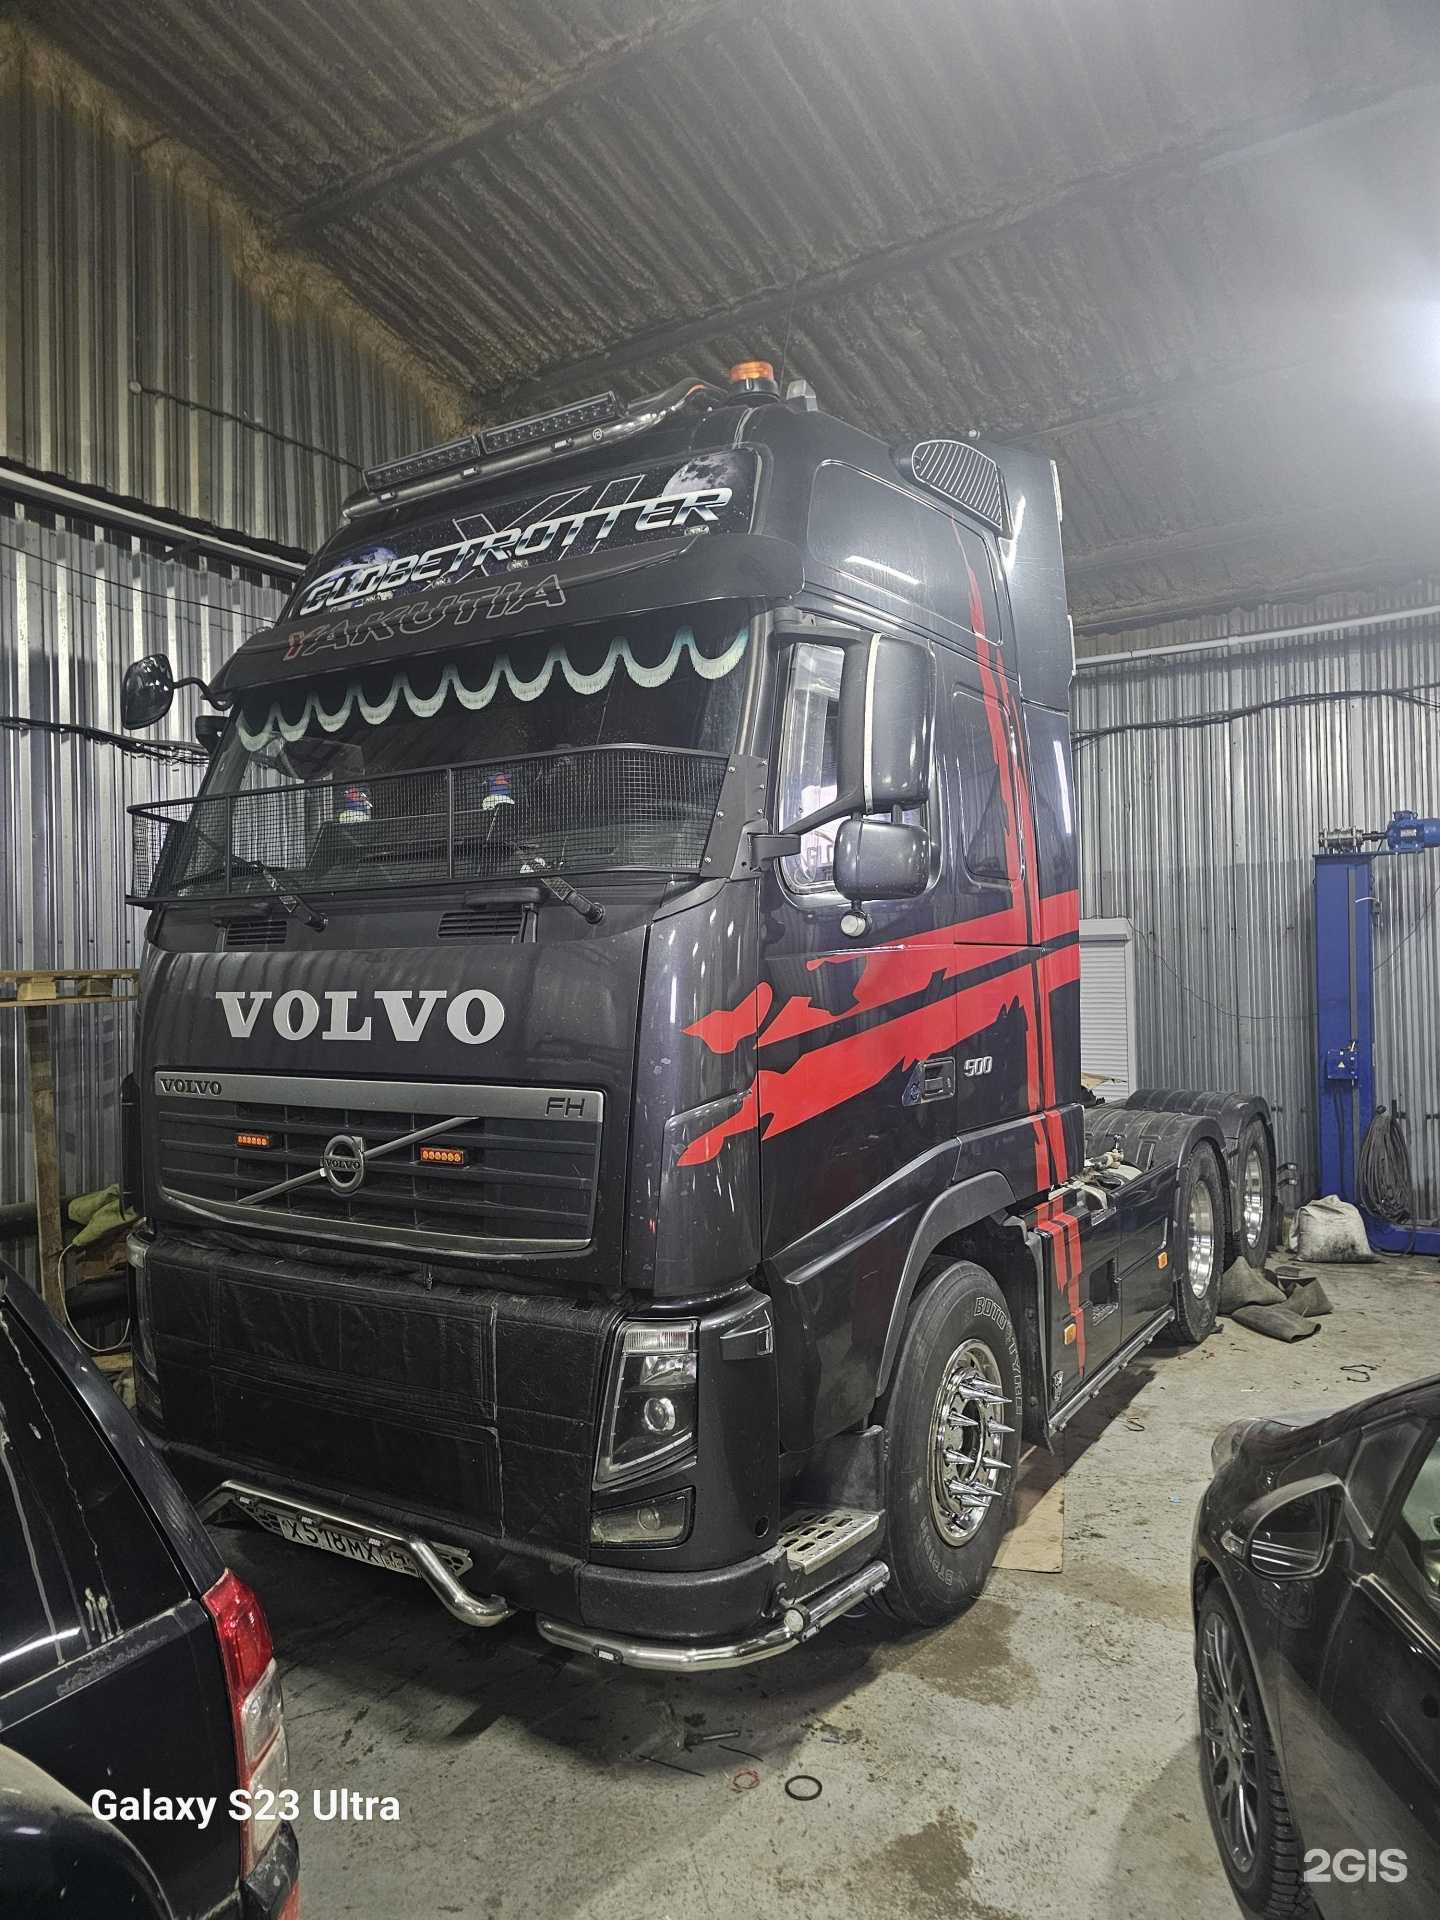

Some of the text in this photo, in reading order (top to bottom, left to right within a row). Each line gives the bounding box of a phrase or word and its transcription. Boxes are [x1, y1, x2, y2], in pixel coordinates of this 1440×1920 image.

[299, 487, 733, 616] GLOBETROTTER
[283, 573, 567, 661] YAKUTIA
[216, 988, 505, 1045] VOLVO
[963, 1056, 993, 1077] 500
[159, 1078, 223, 1096] VOLVO
[545, 1096, 585, 1117] FH
[325, 1158, 361, 1170] VOLVO
[974, 1297, 1007, 1330] BOTO
